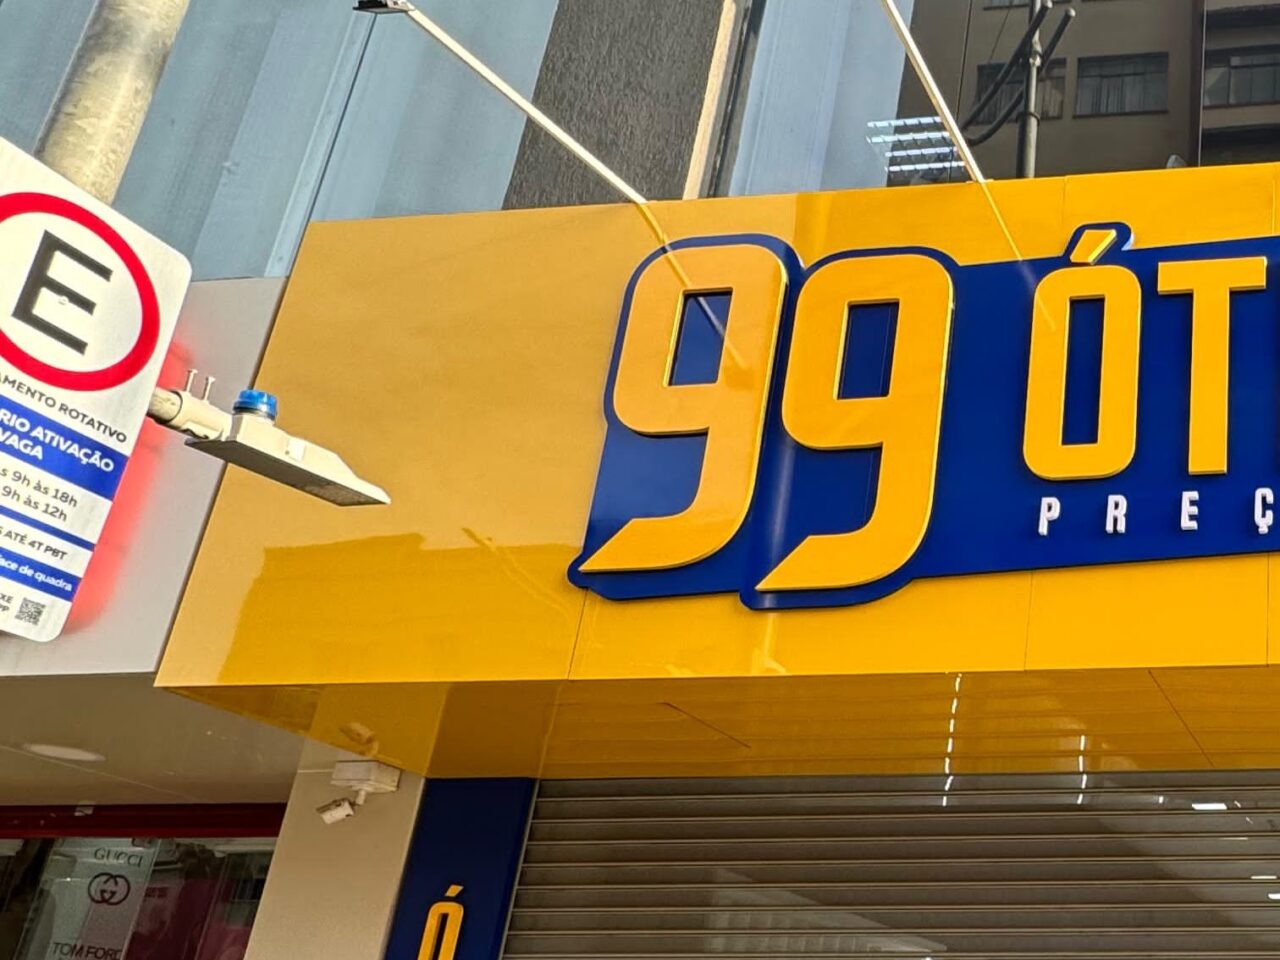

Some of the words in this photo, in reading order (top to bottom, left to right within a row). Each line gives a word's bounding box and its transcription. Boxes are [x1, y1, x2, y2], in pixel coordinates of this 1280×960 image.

[11, 230, 114, 356] E
[58, 402, 127, 443] ROTATIVO
[579, 244, 956, 593] 99
[0, 427, 43, 460] VAGA
[30, 426, 115, 472] ATIVAÇÃO
[1, 485, 21, 501] 9h
[23, 495, 39, 511] às
[42, 503, 68, 522] 12h
[11, 470, 31, 487] 9h
[33, 480, 50, 496] às
[53, 489, 78, 508] 18h
[4, 529, 28, 545] ATÉ
[19, 564, 35, 578] de
[34, 571, 73, 592] quadra
[94, 847, 143, 867] GUCCI
[53, 942, 84, 958] TOM
